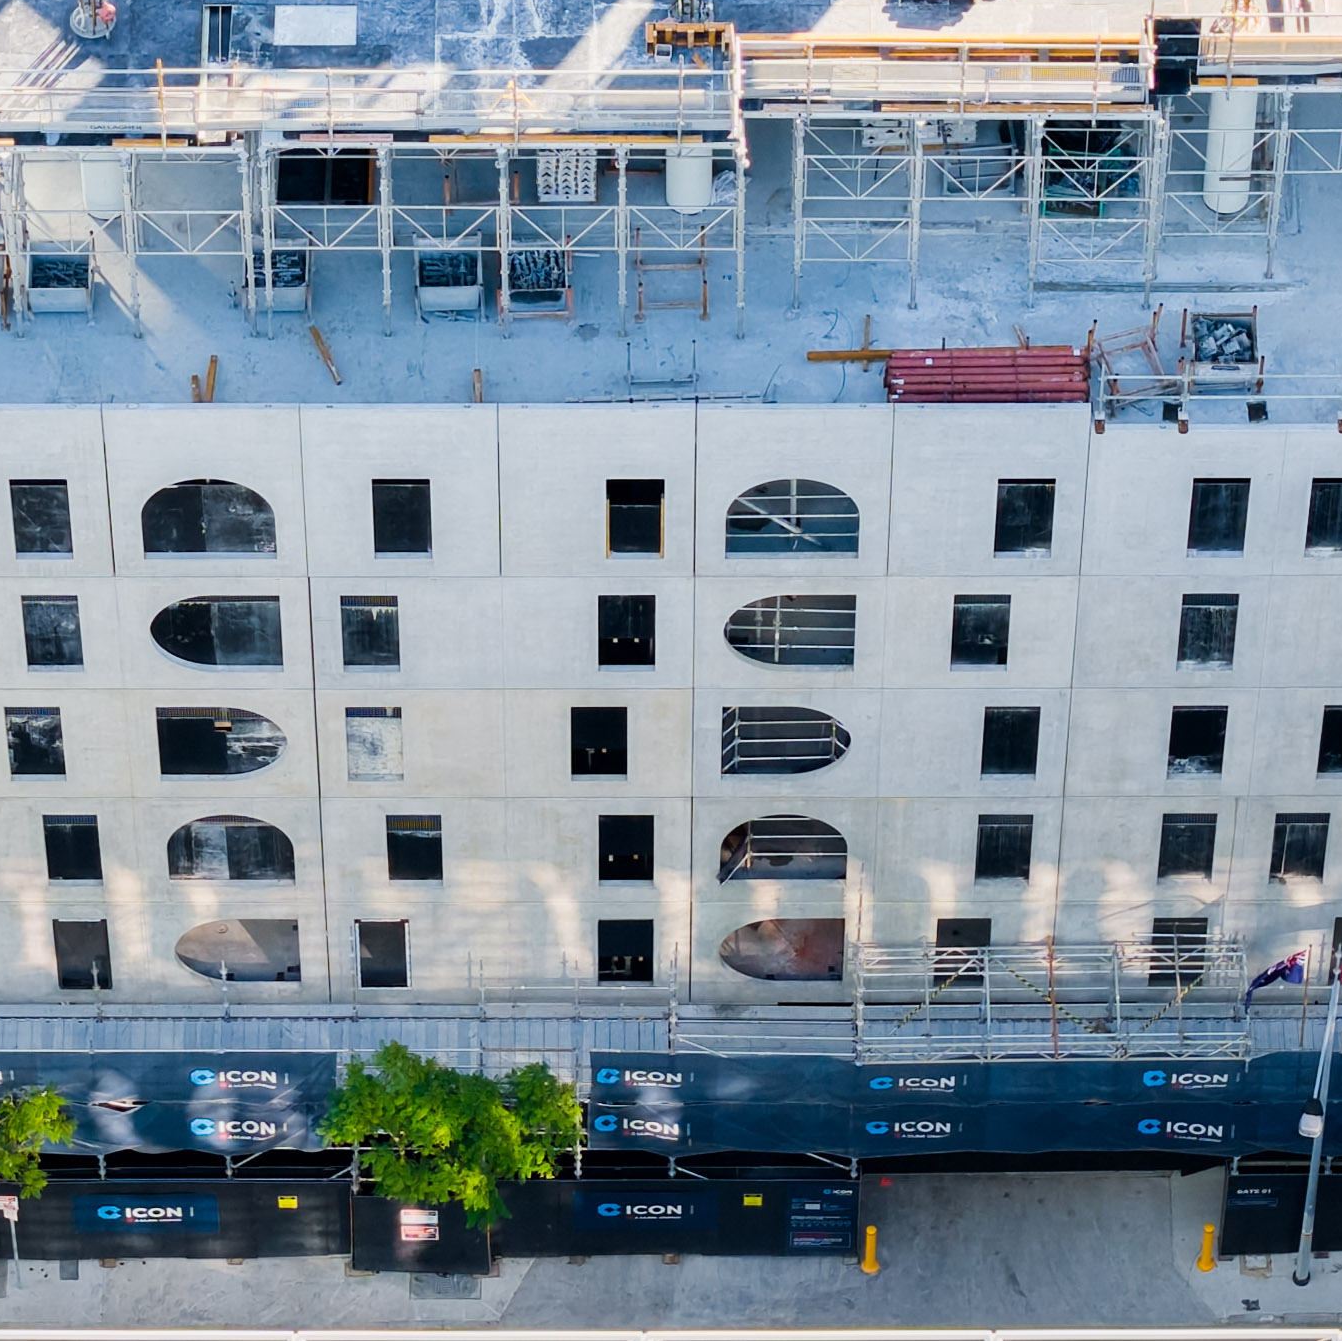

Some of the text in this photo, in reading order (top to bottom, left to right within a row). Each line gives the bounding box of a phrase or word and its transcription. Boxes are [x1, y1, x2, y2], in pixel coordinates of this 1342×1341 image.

[219, 1070, 277, 1084] ICON
[624, 1070, 682, 1083] ICON
[898, 1075, 956, 1088] ICON
[1171, 1073, 1229, 1085] ICON
[218, 1120, 276, 1135] ICON
[622, 1118, 679, 1136] ICON
[894, 1121, 951, 1133] ICON
[1166, 1121, 1223, 1138] ICON
[125, 1207, 183, 1218] ICON
[625, 1205, 682, 1215] ICON
